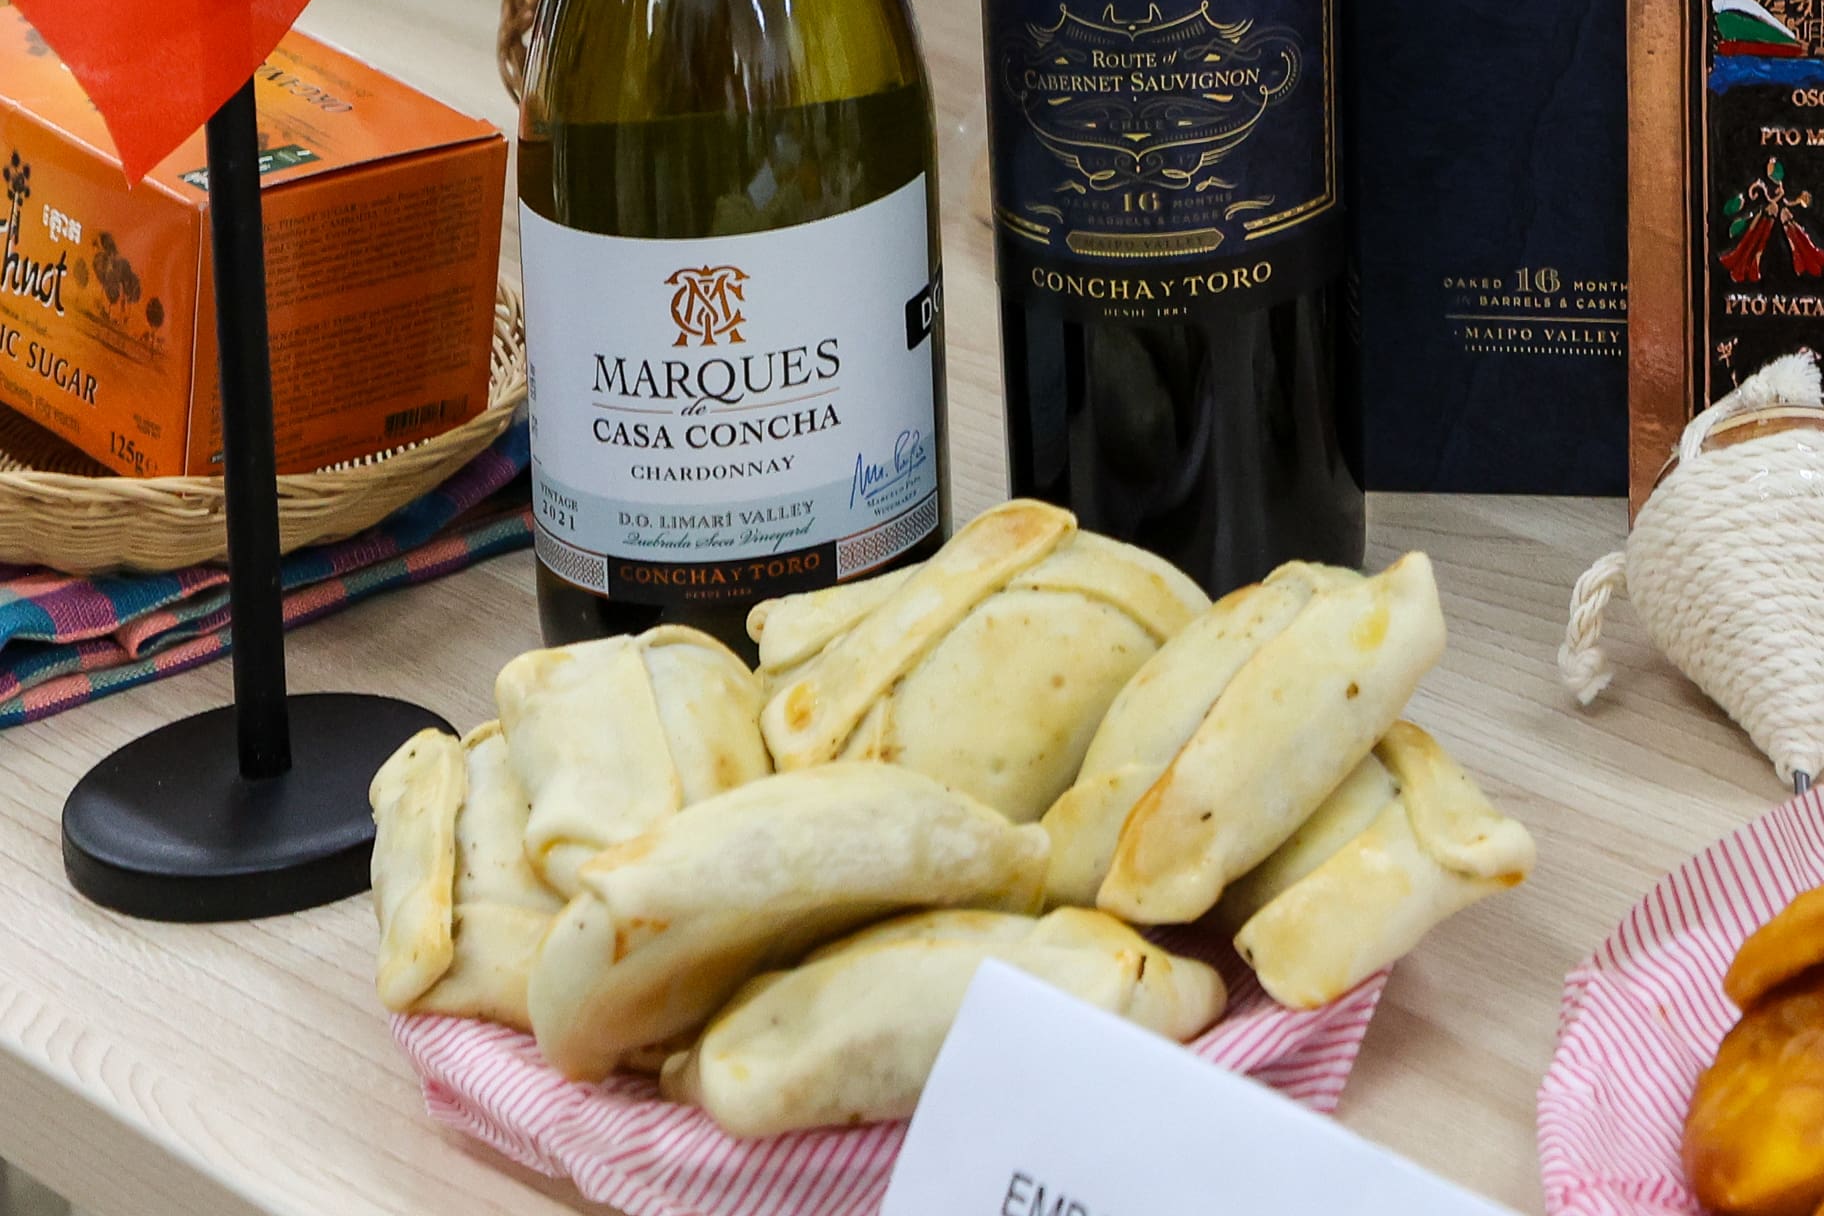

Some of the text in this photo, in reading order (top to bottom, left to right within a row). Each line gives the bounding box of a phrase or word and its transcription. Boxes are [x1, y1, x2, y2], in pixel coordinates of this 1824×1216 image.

[1092, 49, 1158, 69] ROUTE
[1024, 68, 1260, 93] CABERNET SAUVIGNON
[1760, 127, 1801, 147] PTO
[1123, 192, 1161, 213] 16
[1032, 261, 1273, 300] CONCHA Y TORO
[1443, 278, 1502, 289] OAKED
[1514, 267, 1561, 293] 16
[1479, 296, 1551, 309] BARRELS
[1576, 299, 1627, 310] CASKS
[1725, 294, 1767, 316] PTO
[1465, 327, 1621, 343] MAIPO VALLEY
[27, 341, 98, 406] SUGAR
[592, 337, 841, 404] MARQUES
[681, 398, 707, 417] de
[593, 403, 842, 450] CASA CONCHA
[111, 431, 144, 476] 125g
[631, 454, 796, 481] CHARDONNAY
[540, 482, 578, 512] VINTAGE
[542, 499, 576, 531] 2021
[618, 500, 815, 529] D.O. LIMARÍ VALLEY
[622, 531, 690, 549] Quebrada
[739, 517, 816, 553] Vineyard
[619, 564, 726, 586] CONCHA
[751, 552, 821, 581] TORO
